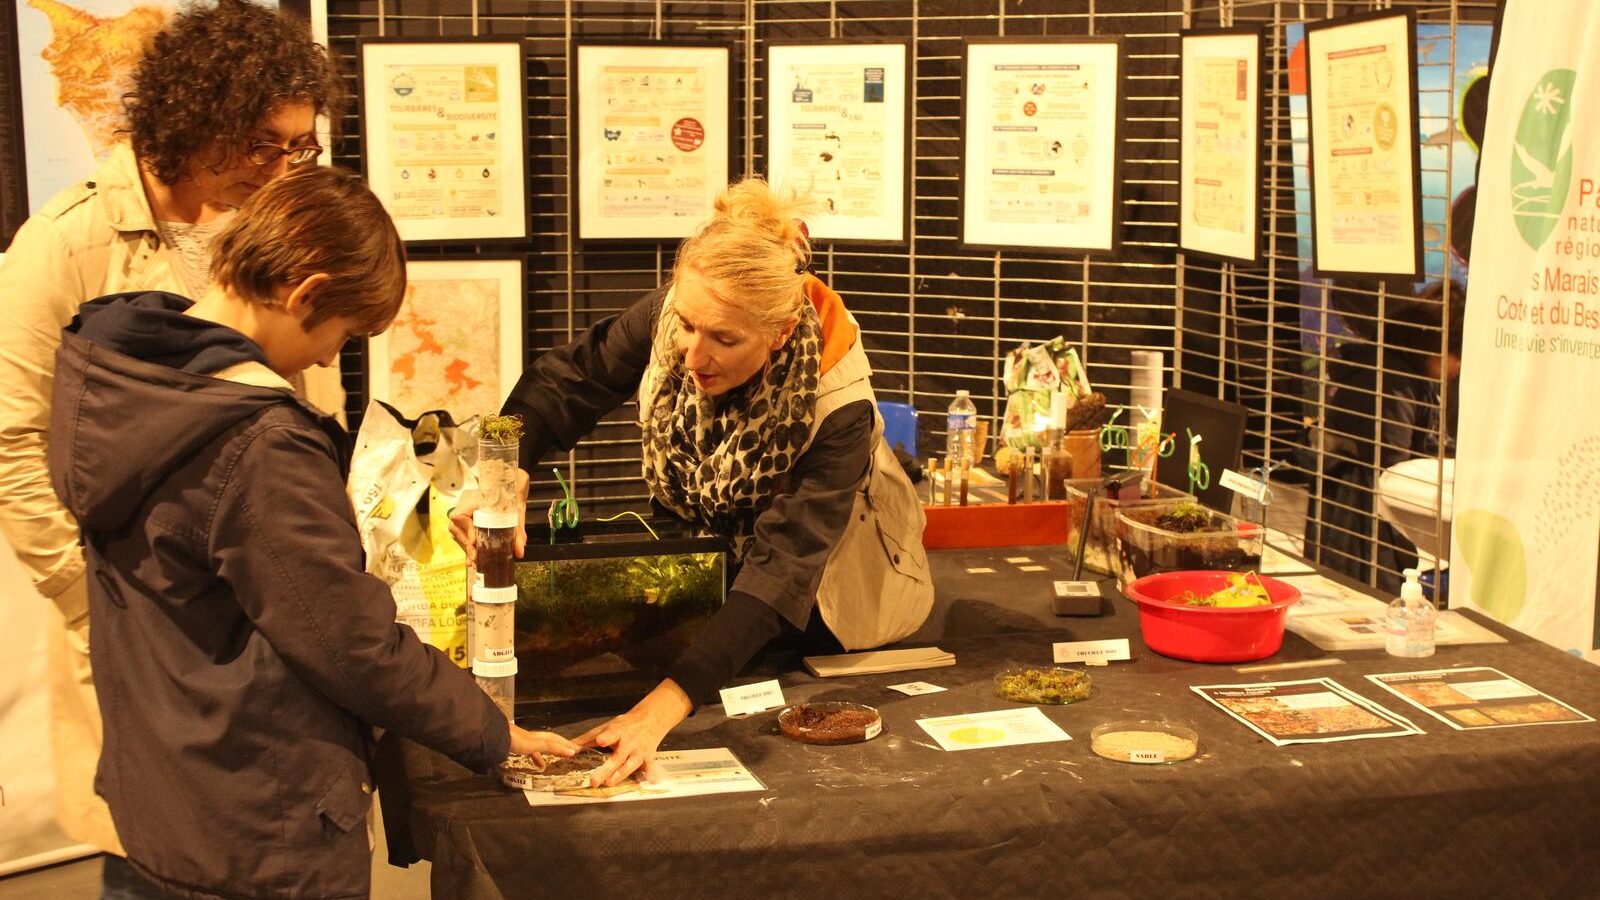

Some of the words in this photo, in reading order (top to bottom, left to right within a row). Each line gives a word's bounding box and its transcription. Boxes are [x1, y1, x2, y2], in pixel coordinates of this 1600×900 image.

[436, 107, 445, 118] &
[1543, 267, 1600, 296] Marais
[1530, 301, 1545, 325] et
[1549, 300, 1570, 325] du
[1495, 327, 1518, 350] Une
